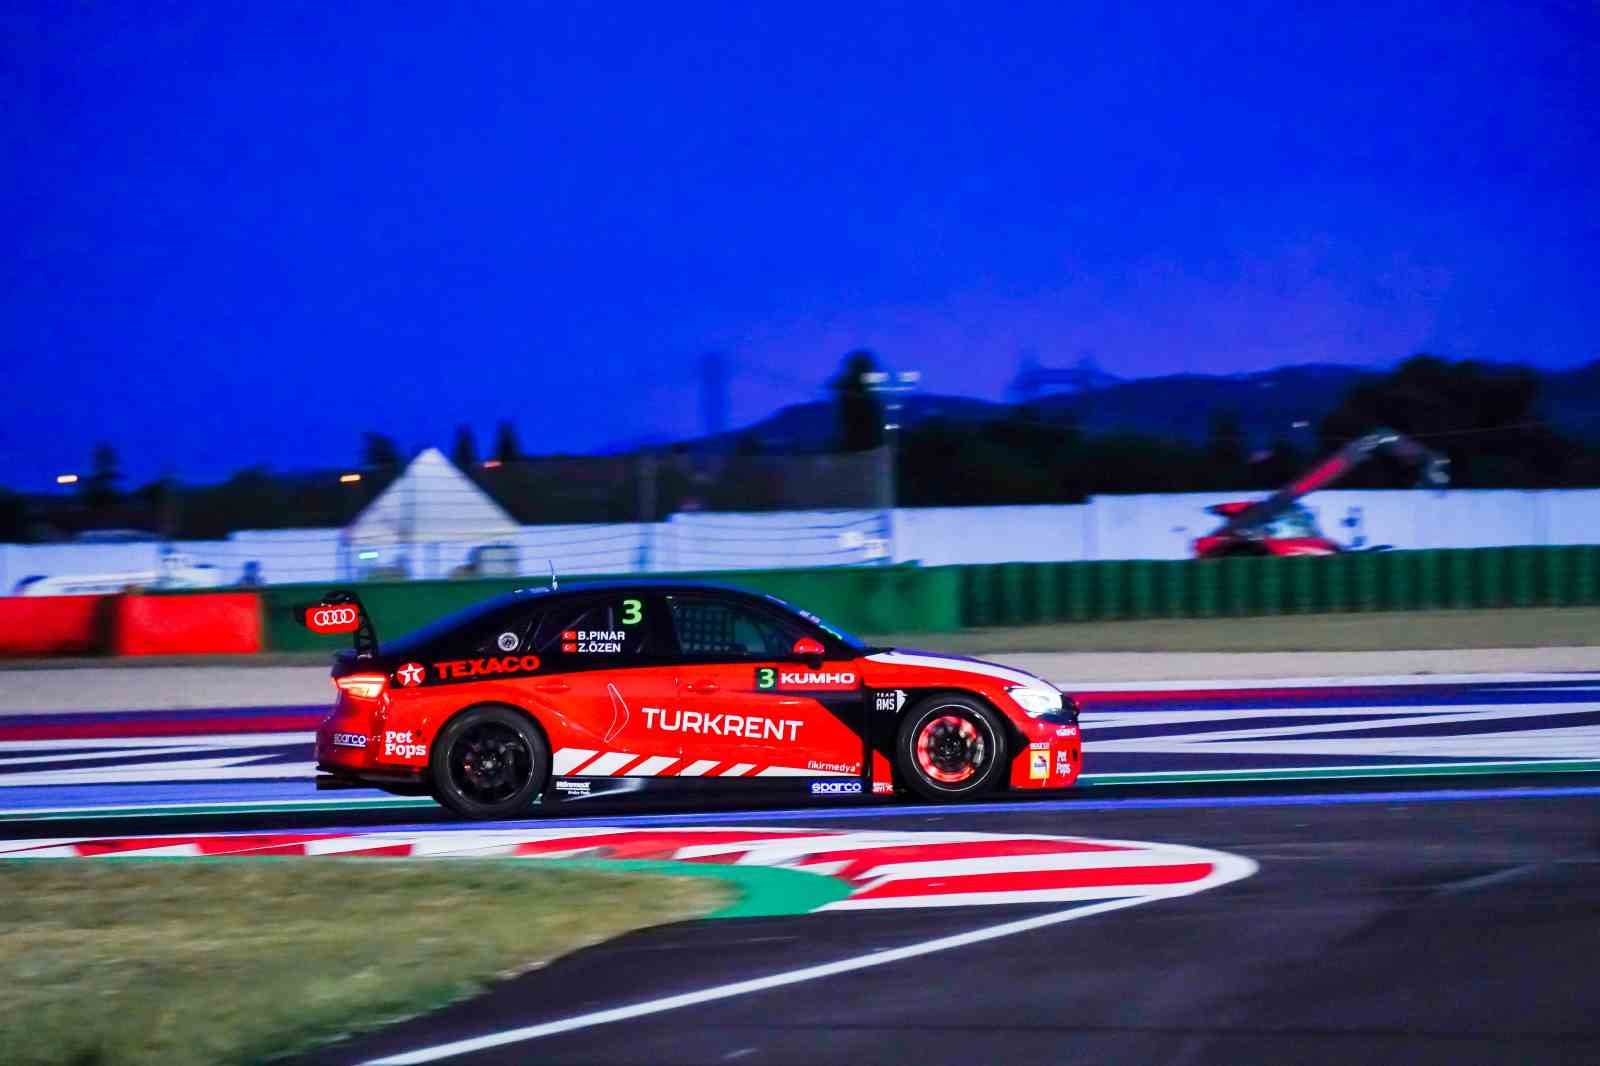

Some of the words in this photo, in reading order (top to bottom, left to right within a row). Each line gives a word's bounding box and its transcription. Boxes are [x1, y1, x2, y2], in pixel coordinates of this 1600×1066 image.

[622, 599, 642, 625] 3
[577, 640, 621, 652] Z.ÖZEN
[433, 655, 541, 679] TEXACO
[759, 668, 775, 688] 3
[781, 672, 855, 685] KUMHO
[641, 707, 804, 742] TURKRENT
[385, 730, 413, 744] Pet
[385, 744, 427, 759] Pops
[808, 760, 857, 773] fikirmedya
[811, 782, 862, 793] sparco
